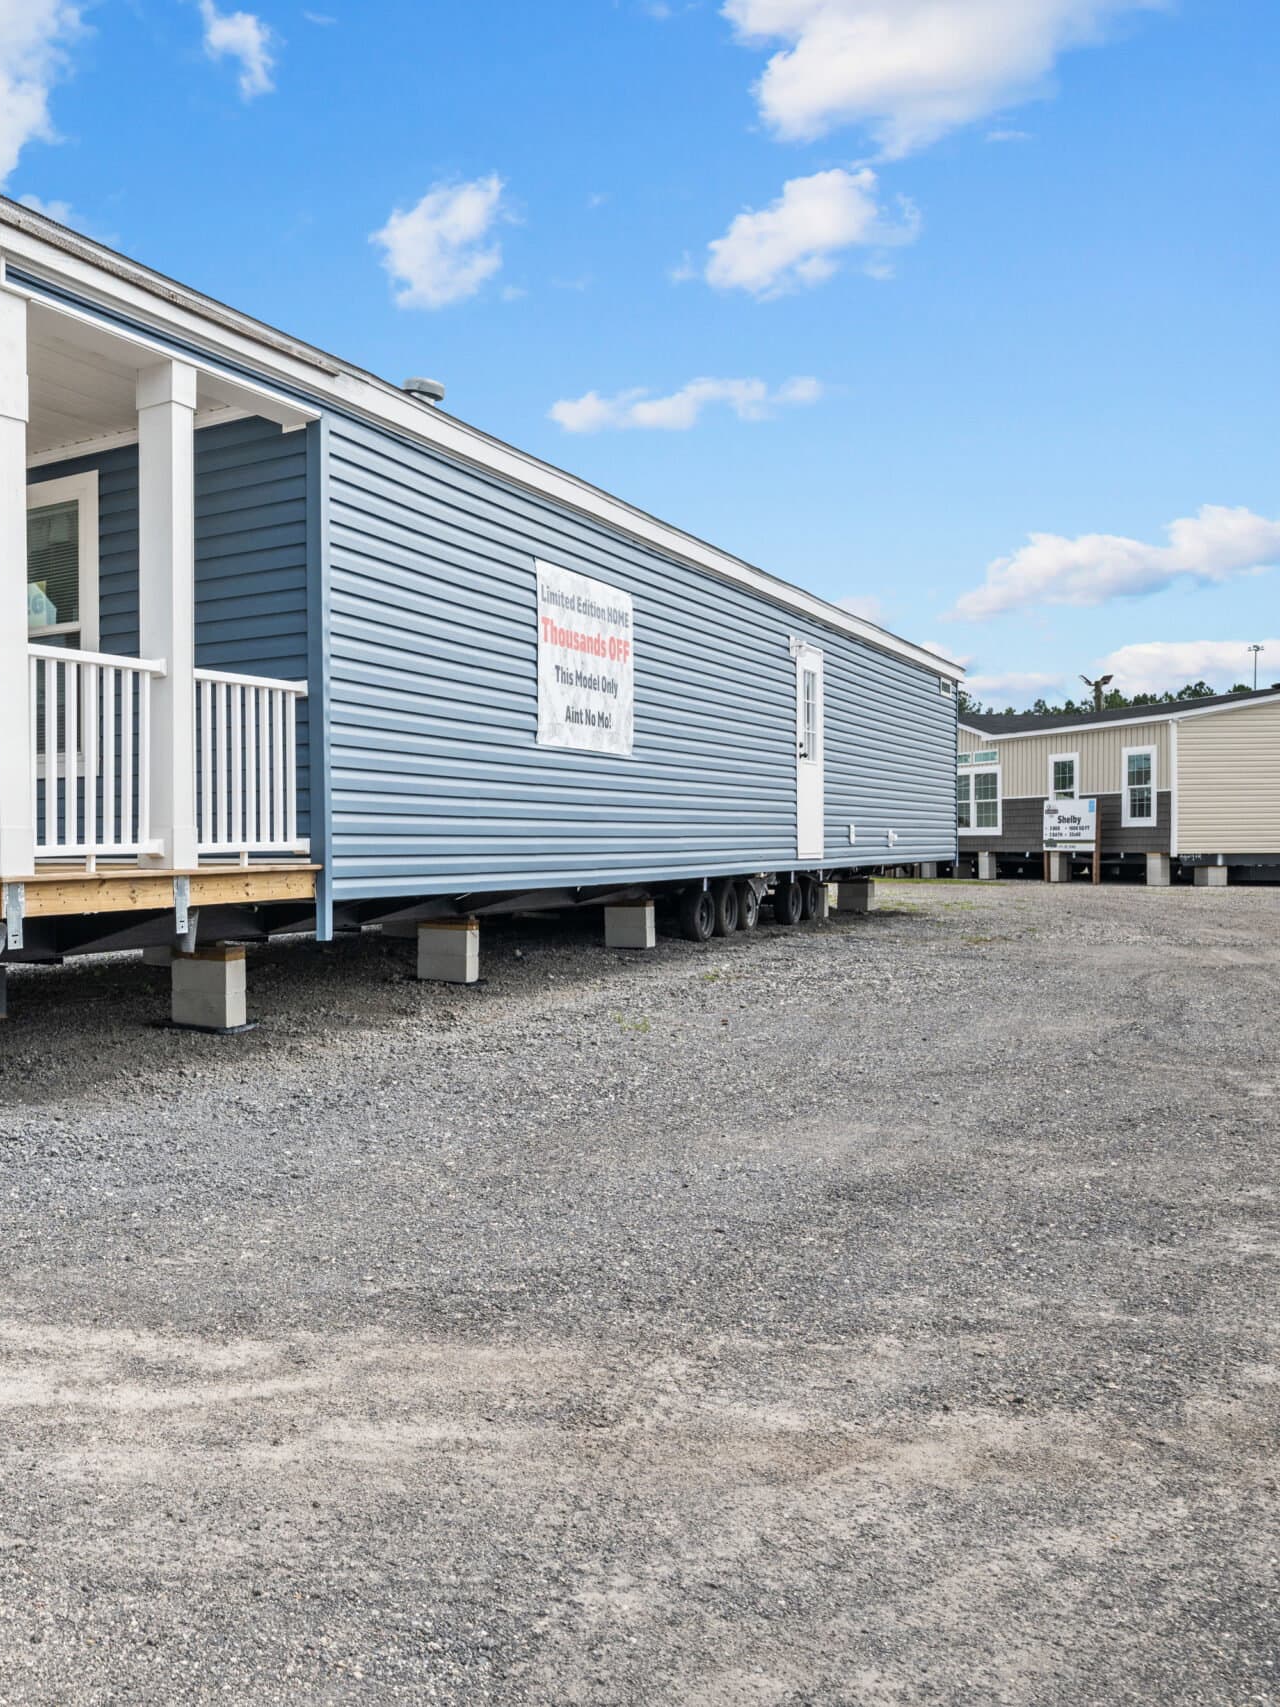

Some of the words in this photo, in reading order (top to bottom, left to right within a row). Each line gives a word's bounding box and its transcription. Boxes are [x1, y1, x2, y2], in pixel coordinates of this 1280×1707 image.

[541, 584, 575, 610] Limited
[577, 596, 606, 621] Edition
[607, 607, 629, 628] HOME
[541, 616, 607, 658] Thousands
[609, 636, 630, 664] OFF
[554, 664, 574, 686] This
[575, 669, 600, 691] Model
[601, 676, 619, 699] Only
[565, 705, 584, 725] Aint
[585, 708, 596, 727] No
[597, 711, 612, 729] Mo!
[1057, 815, 1082, 825] Shelby
